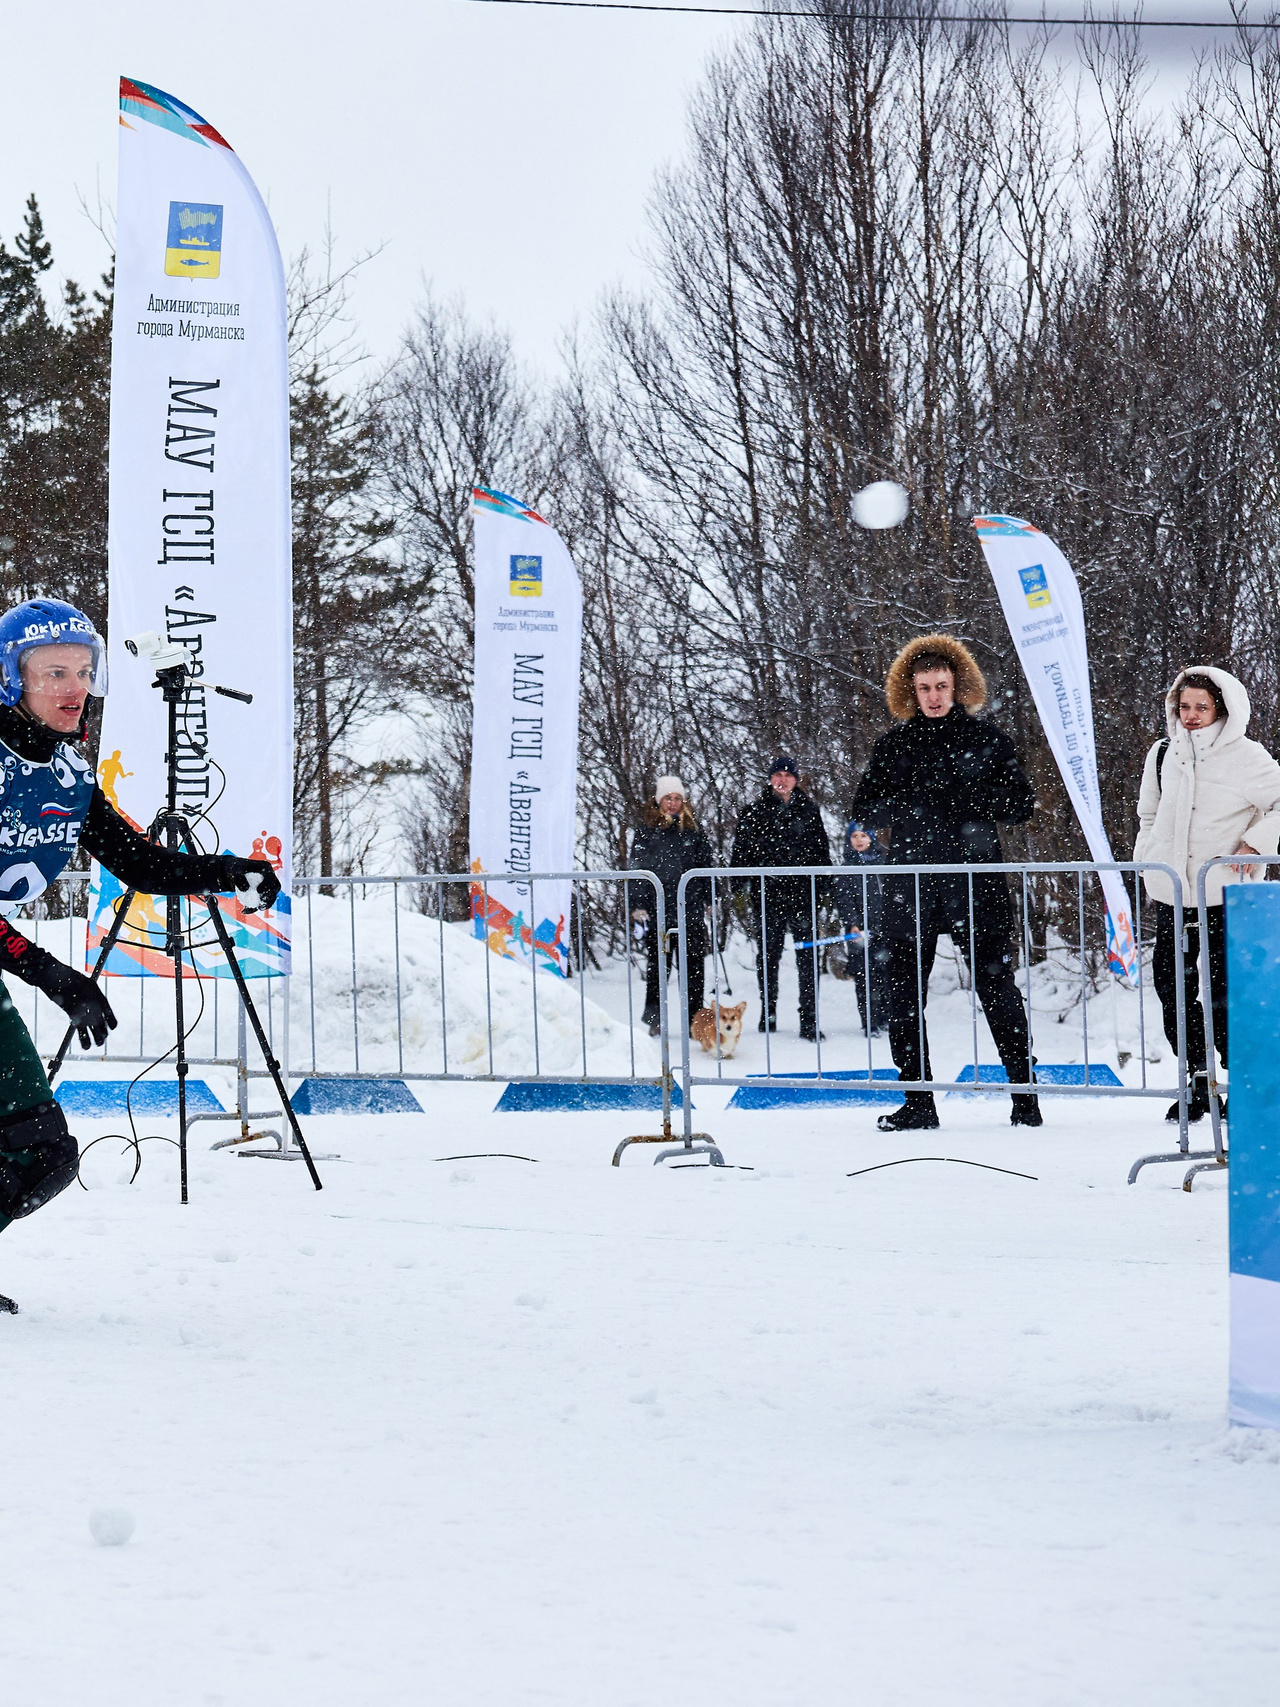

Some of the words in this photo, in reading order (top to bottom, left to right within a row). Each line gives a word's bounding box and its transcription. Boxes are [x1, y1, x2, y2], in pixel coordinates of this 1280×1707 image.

[147, 294, 240, 317] Администрация
[137, 321, 173, 338] города
[178, 319, 245, 341] Мурманска
[164, 376, 220, 473] МАУ
[157, 489, 214, 565] ГСЦ
[513, 653, 544, 707] МАУ
[507, 717, 543, 760] ГСЦ
